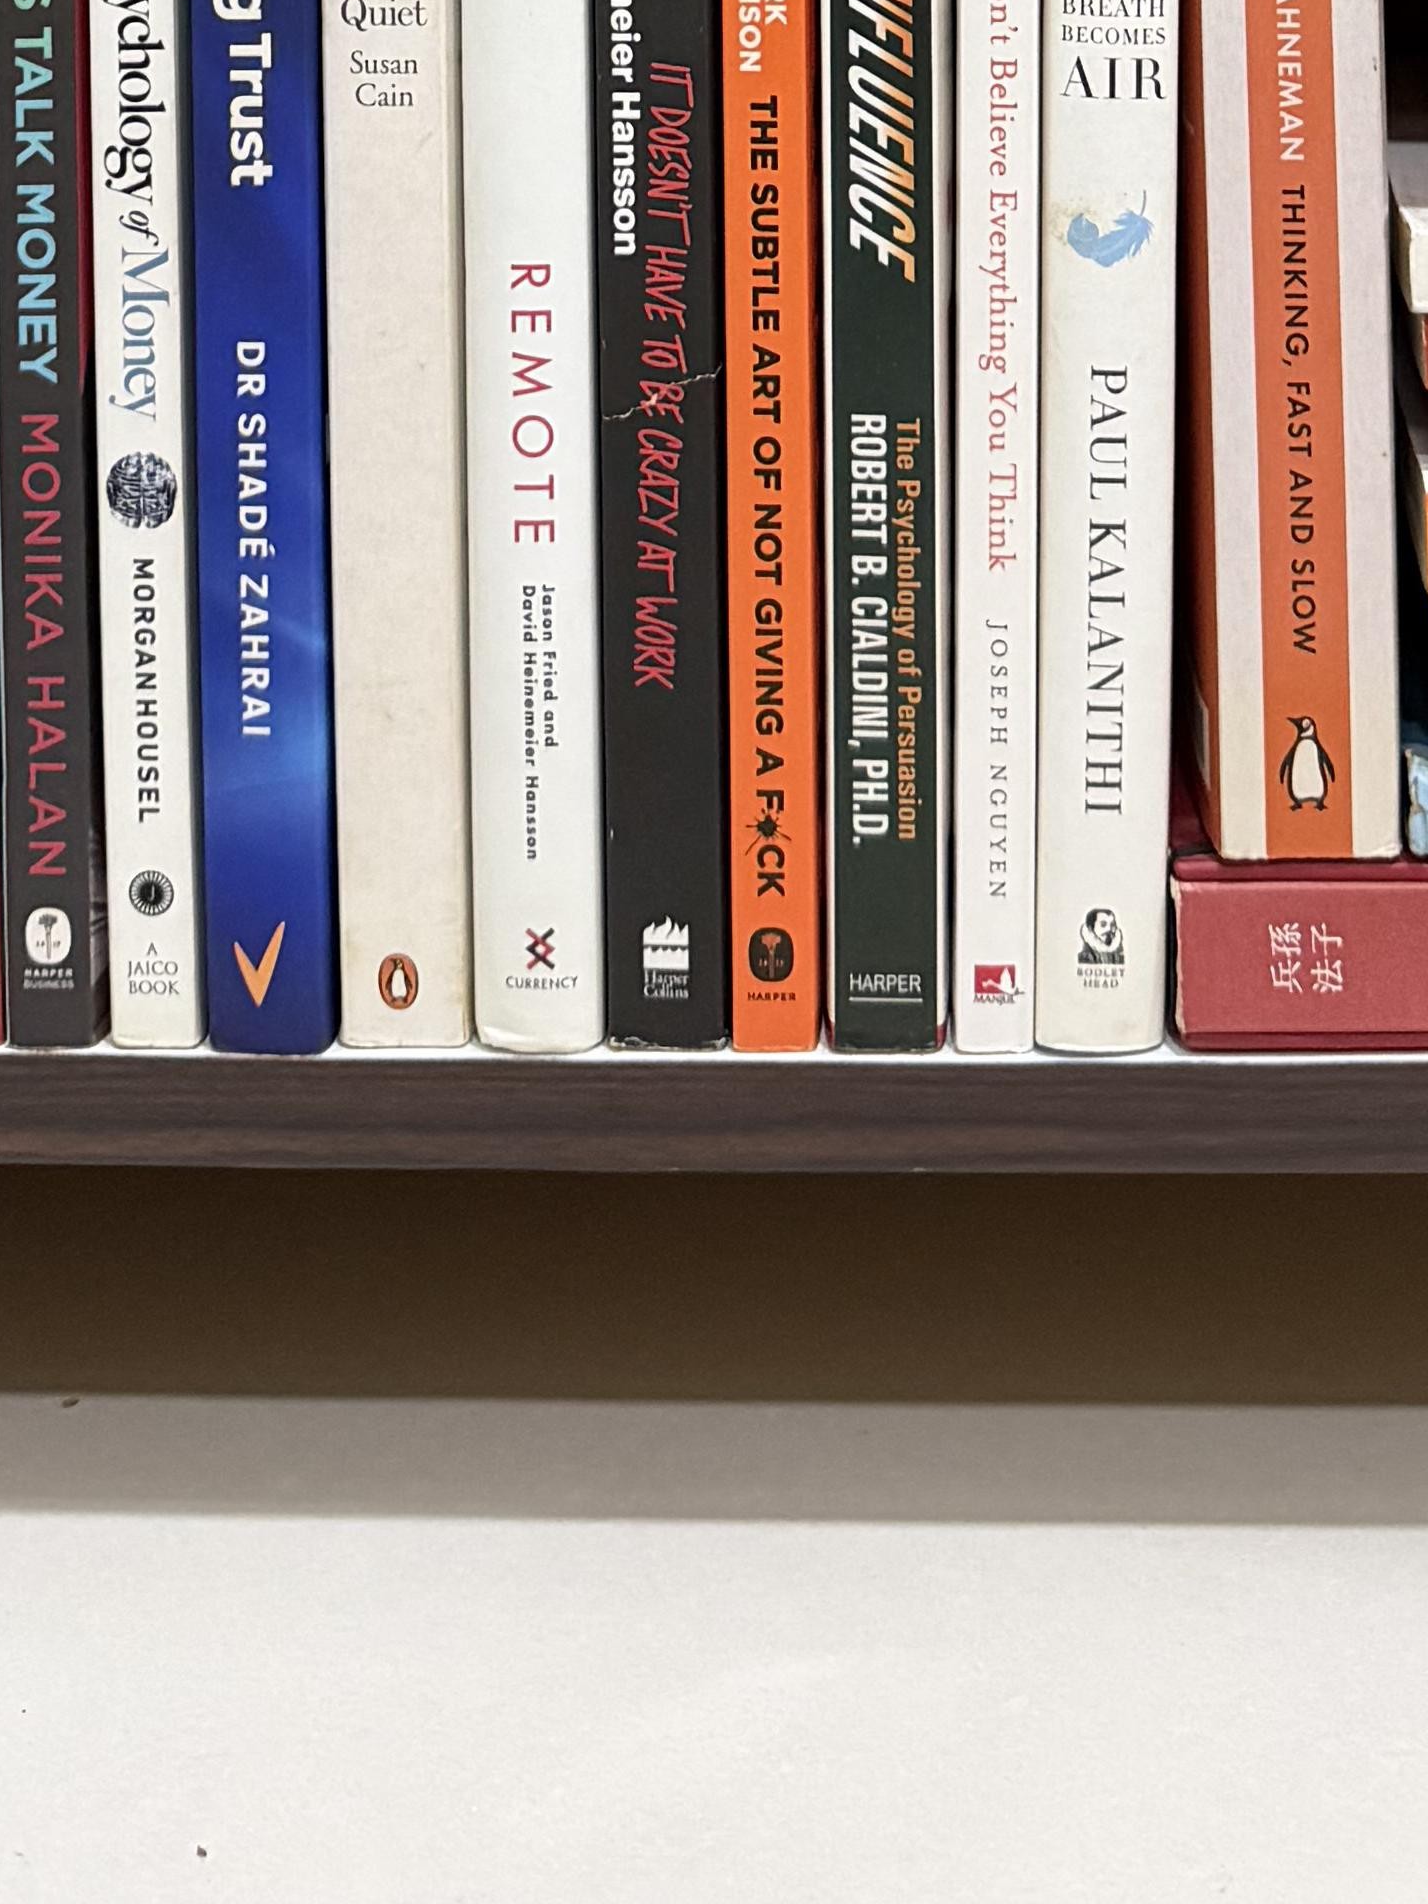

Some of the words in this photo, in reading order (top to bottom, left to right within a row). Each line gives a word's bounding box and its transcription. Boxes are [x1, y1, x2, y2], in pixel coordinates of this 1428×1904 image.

[1061, 21, 1167, 46] BECOMES
[348, 48, 419, 77] Susan
[1062, 55, 1167, 102] AIR
[226, 31, 274, 189] Trust
[355, 81, 415, 108] Cain
[123, 210, 158, 244] of
[117, 248, 170, 423] Money
[234, 341, 262, 398] DR
[509, 262, 557, 547] REMOTE
[235, 410, 275, 558] SHADÉ
[237, 568, 271, 738] ZAHRAI
[505, 971, 579, 991] CURRENCY
[849, 970, 922, 995] HARPER
